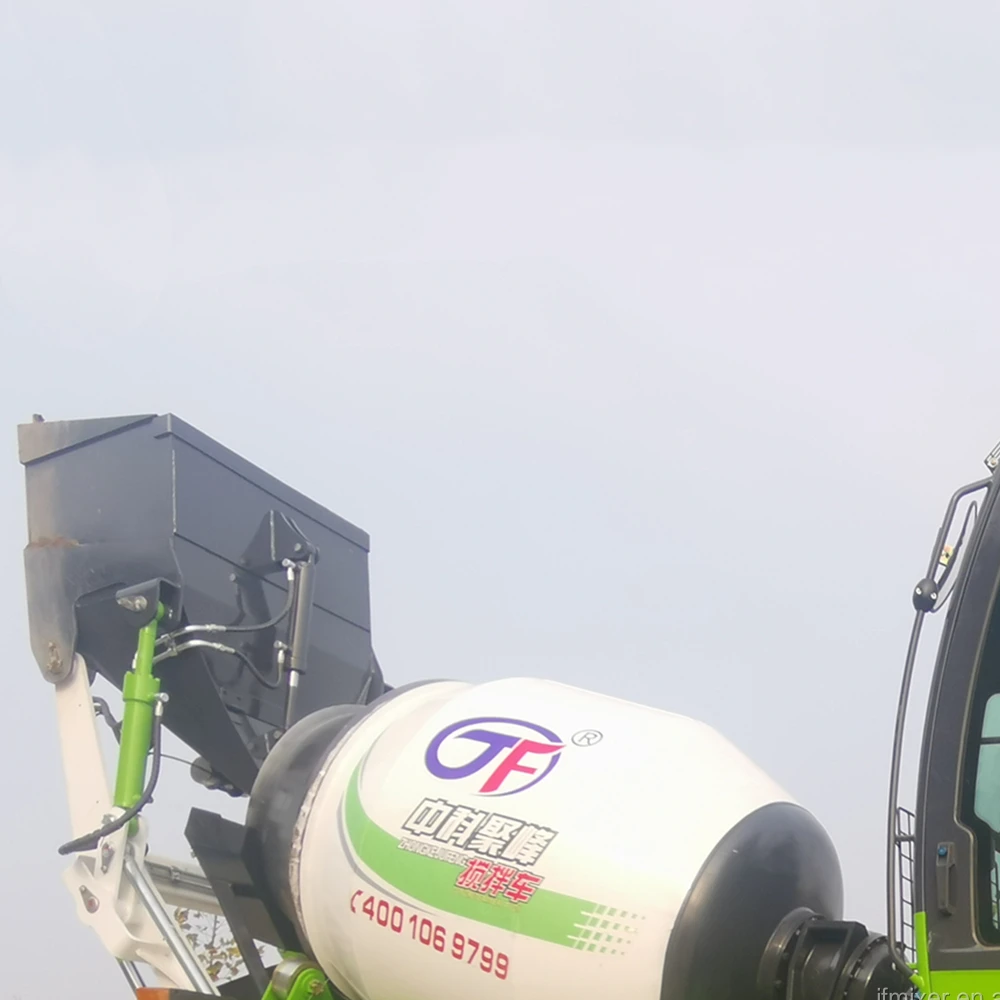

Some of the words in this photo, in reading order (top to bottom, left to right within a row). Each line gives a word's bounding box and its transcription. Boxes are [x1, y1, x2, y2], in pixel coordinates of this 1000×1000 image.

[401, 796, 559, 867] 中科聚峰
[454, 856, 545, 905] 搅拌车
[361, 894, 404, 934] 400
[408, 914, 447, 953] 106
[451, 932, 510, 980] 9799
